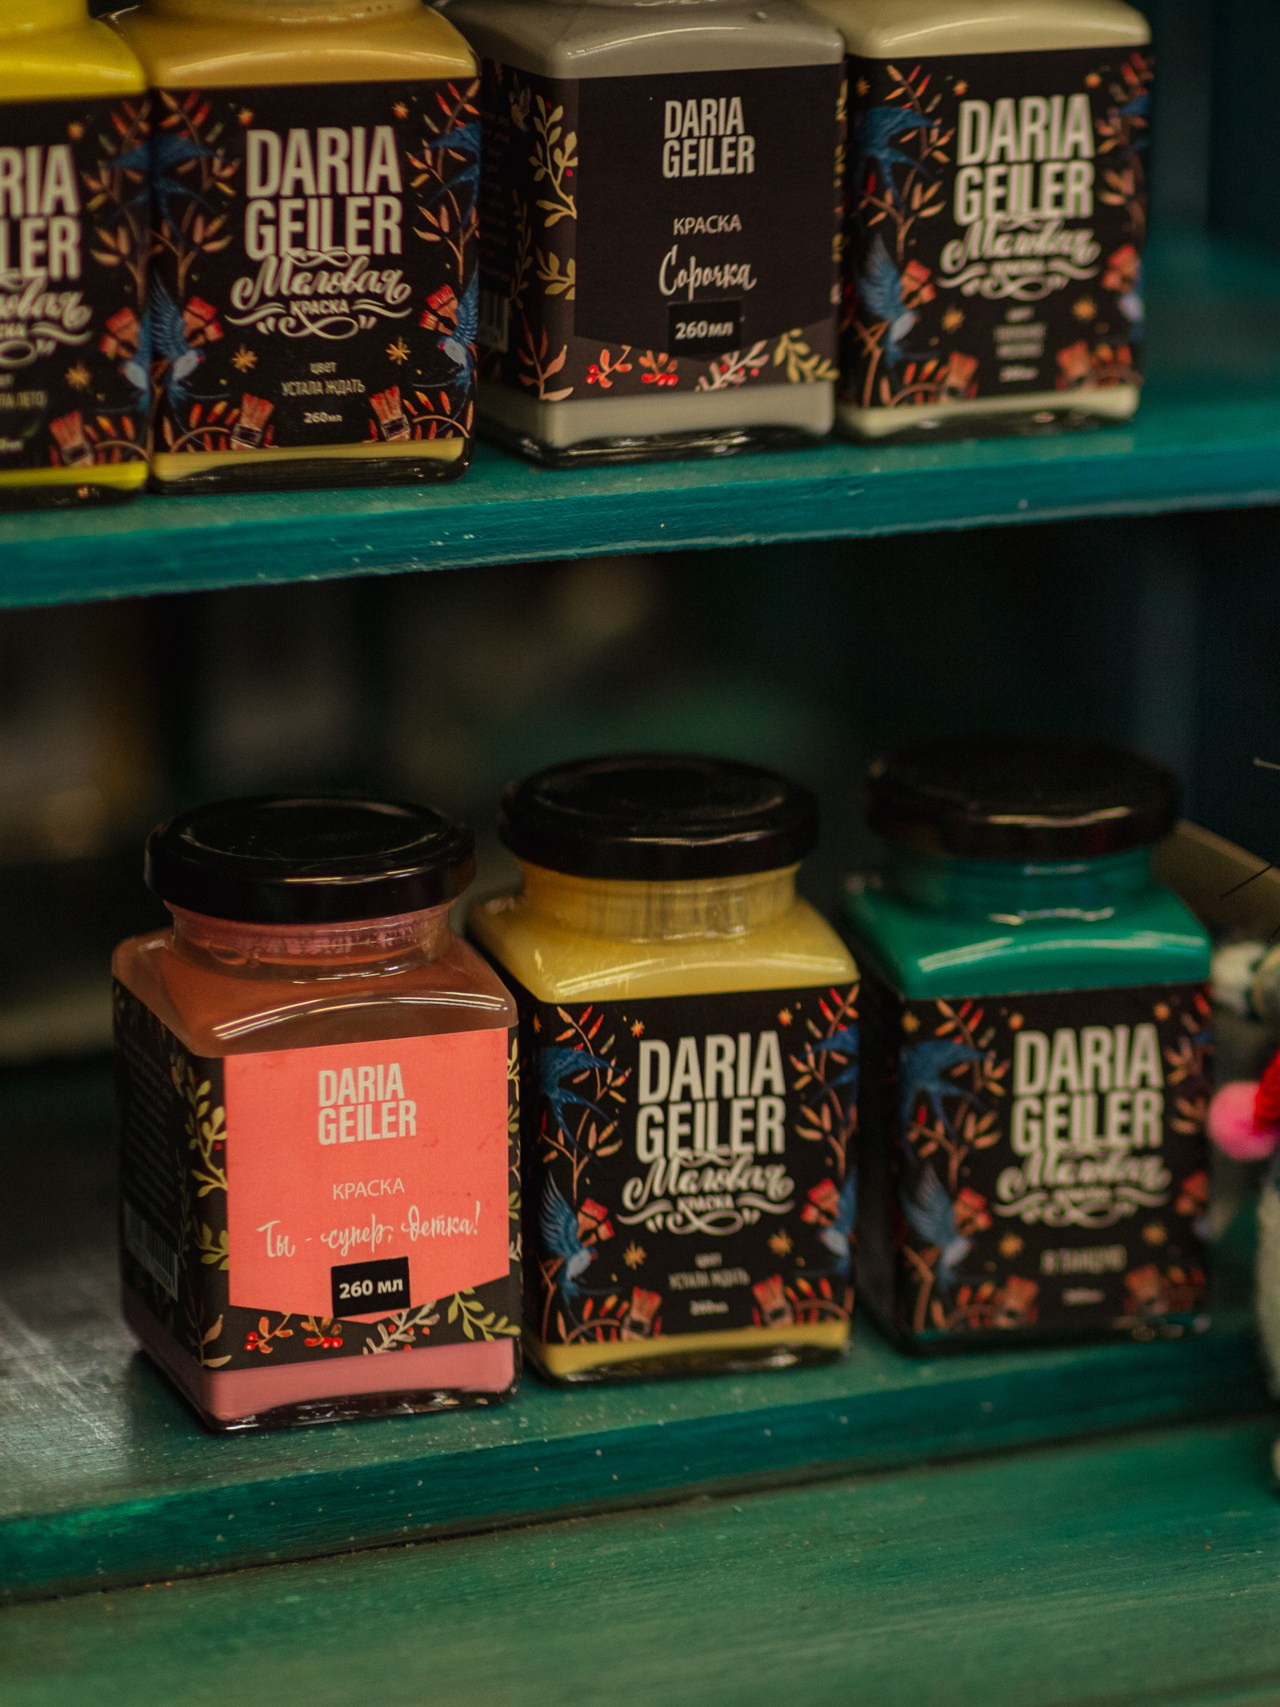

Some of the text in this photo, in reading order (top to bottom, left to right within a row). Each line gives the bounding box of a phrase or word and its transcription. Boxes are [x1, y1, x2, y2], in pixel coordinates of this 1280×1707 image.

[664, 96, 745, 140] DARIA
[957, 94, 1096, 166] DARIA
[0, 144, 79, 218] RIA
[246, 125, 402, 198] DARIA
[662, 135, 757, 179] GEILER
[954, 160, 1096, 226] GEILER
[0, 215, 81, 280] LER
[244, 195, 402, 261] GEILER
[673, 214, 743, 236] КРАСКА
[231, 254, 412, 311] Меловая
[658, 244, 757, 302] Сорочка
[289, 299, 350, 316] КРАСКА
[675, 320, 735, 341] 260мл
[318, 1063, 405, 1107] DARIA
[637, 1030, 786, 1105] DARIA
[1014, 1023, 1165, 1097] DARIA
[318, 1100, 417, 1145] GEILER
[636, 1096, 786, 1163] GEILER
[1010, 1089, 1164, 1158] GEILER
[333, 1178, 405, 1200] КРАСКА
[256, 1220, 296, 1258] Ты
[401, 1200, 481, 1242] детка!
[339, 1278, 404, 1300] 260 мл
